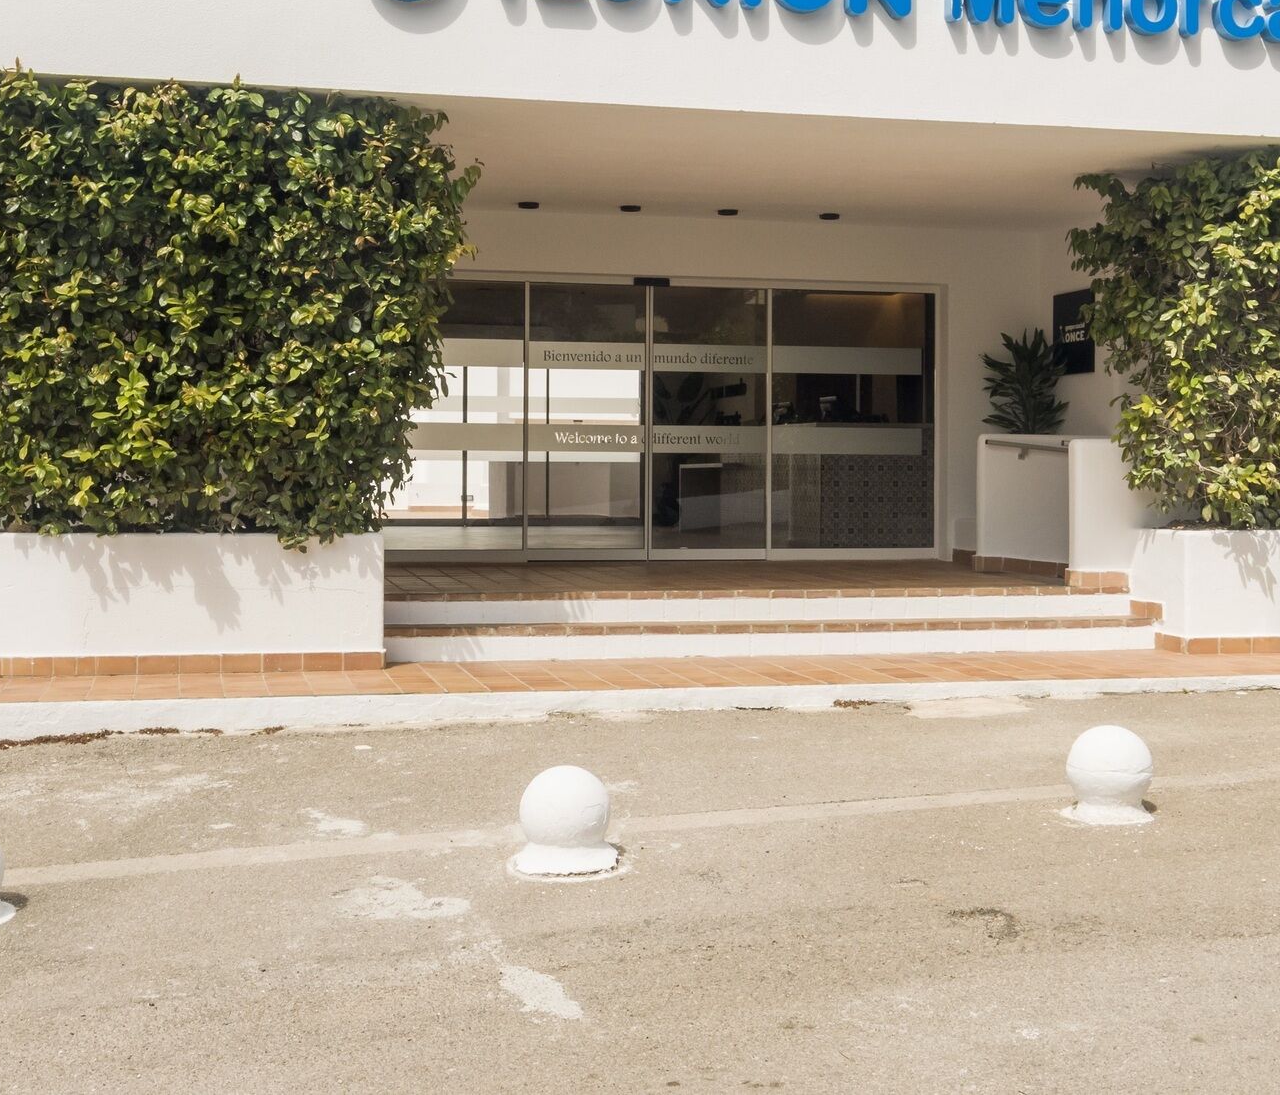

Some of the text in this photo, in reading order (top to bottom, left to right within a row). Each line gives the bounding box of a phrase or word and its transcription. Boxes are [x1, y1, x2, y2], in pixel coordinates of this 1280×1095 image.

[1064, 330, 1085, 343] ONCE
[543, 349, 754, 366] Bienvenido a un mundo diferente
[555, 432, 613, 444] Welcome
[615, 433, 628, 444] to
[630, 435, 638, 444] a
